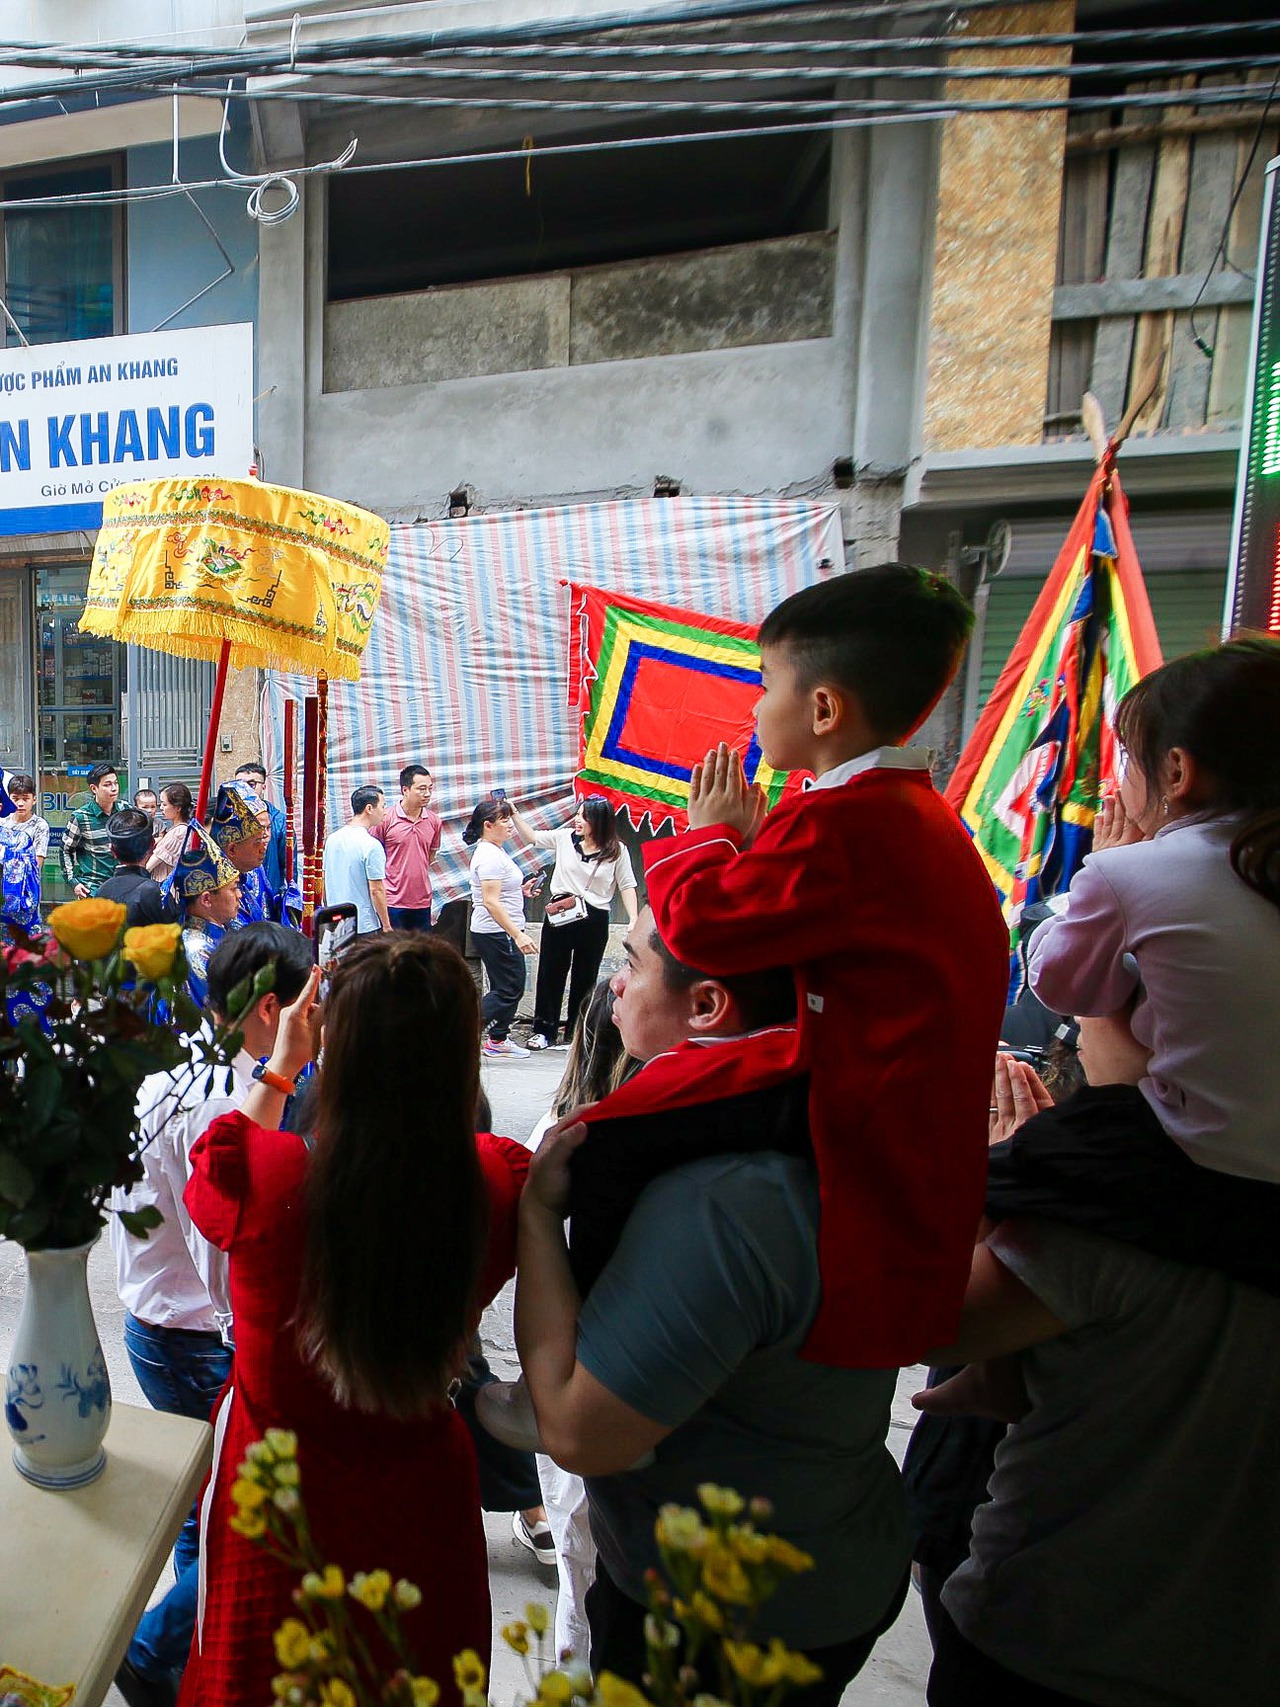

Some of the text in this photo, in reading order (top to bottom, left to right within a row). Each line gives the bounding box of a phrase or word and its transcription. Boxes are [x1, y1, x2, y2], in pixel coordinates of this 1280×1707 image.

[31, 360, 82, 389] PHẨM
[87, 363, 112, 384] AN
[117, 357, 179, 380] KHANG
[47, 402, 216, 469] KHANG
[41, 478, 126, 497] Giờ Mở Cử
